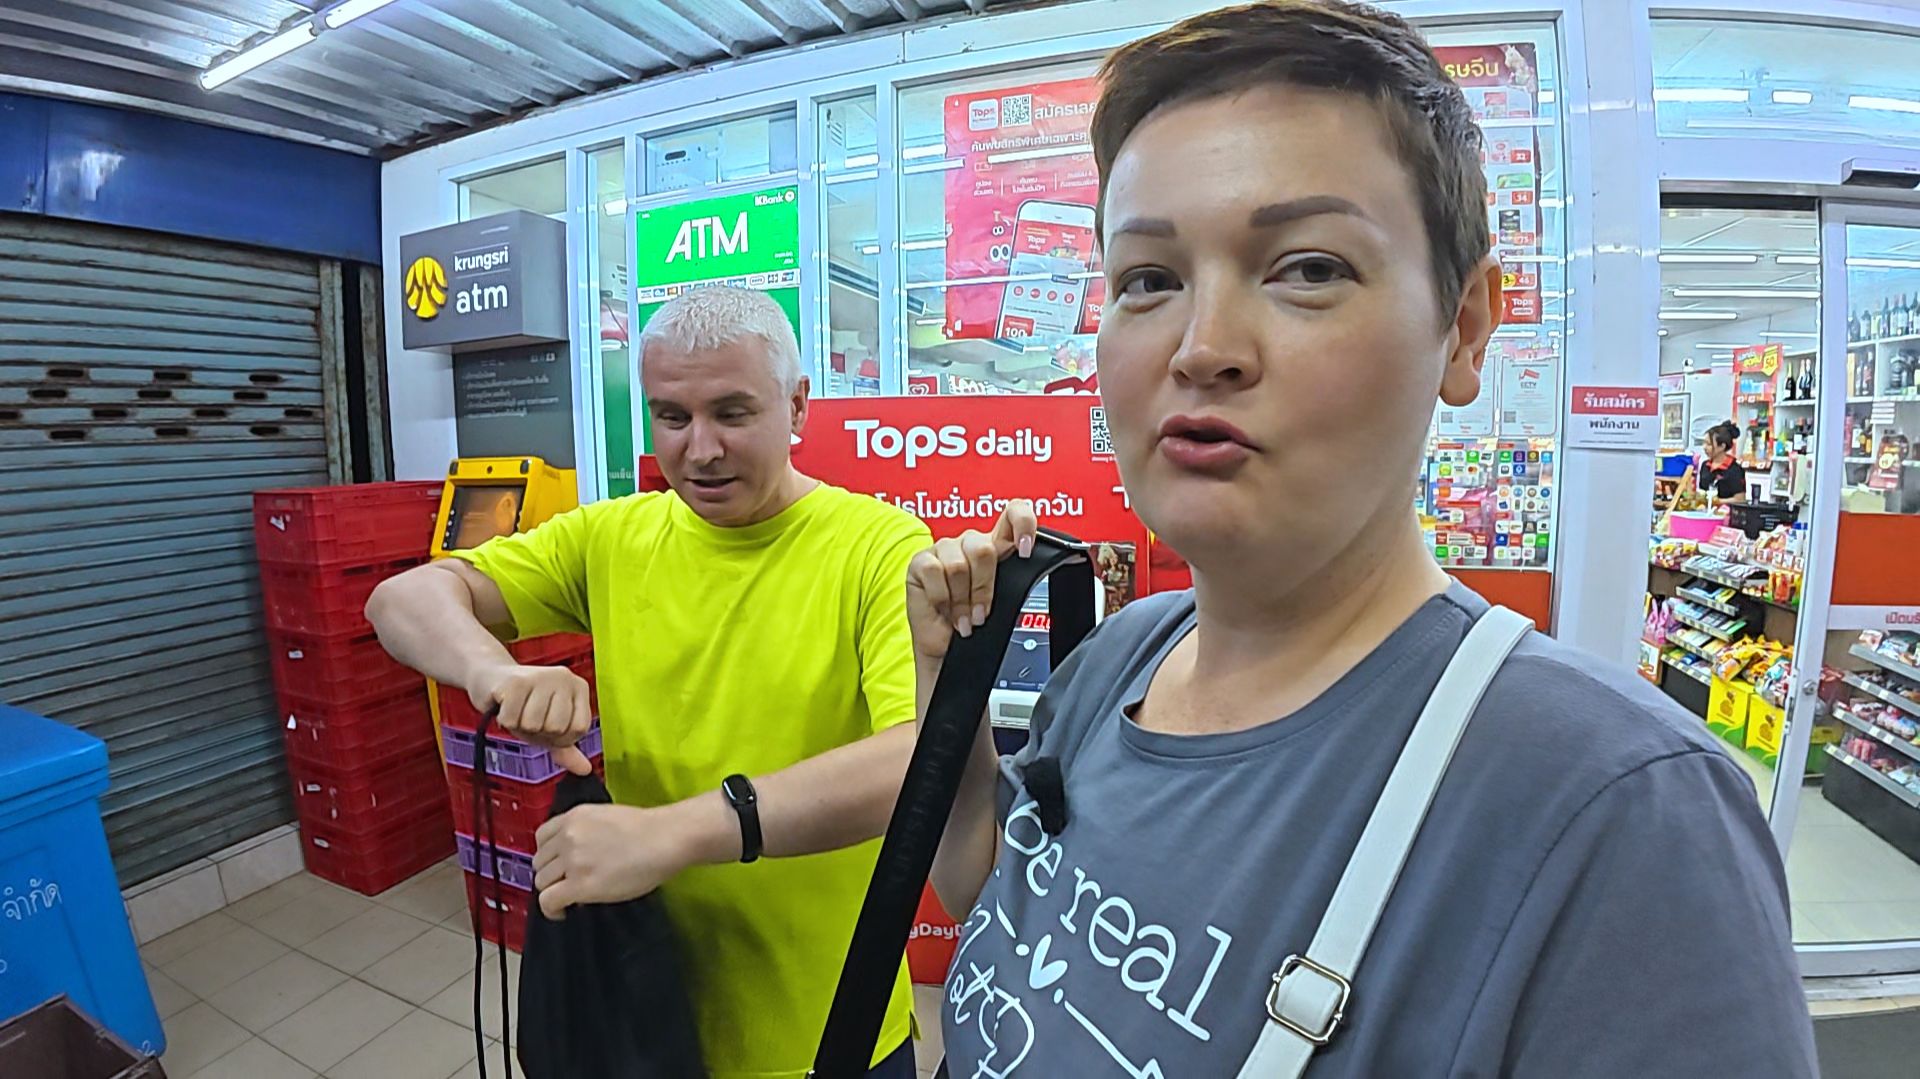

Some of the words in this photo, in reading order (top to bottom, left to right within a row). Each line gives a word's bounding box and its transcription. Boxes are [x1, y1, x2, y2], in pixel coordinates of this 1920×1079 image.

[665, 211, 748, 263] ATM
[454, 246, 509, 272] krungsri
[456, 283, 508, 314] atm
[1584, 392, 1646, 409] รับสมัคร
[1589, 418, 1640, 429] พนักงาน
[844, 419, 968, 468] Tops
[976, 428, 1052, 463] daily
[1060, 867, 1232, 1041] real
